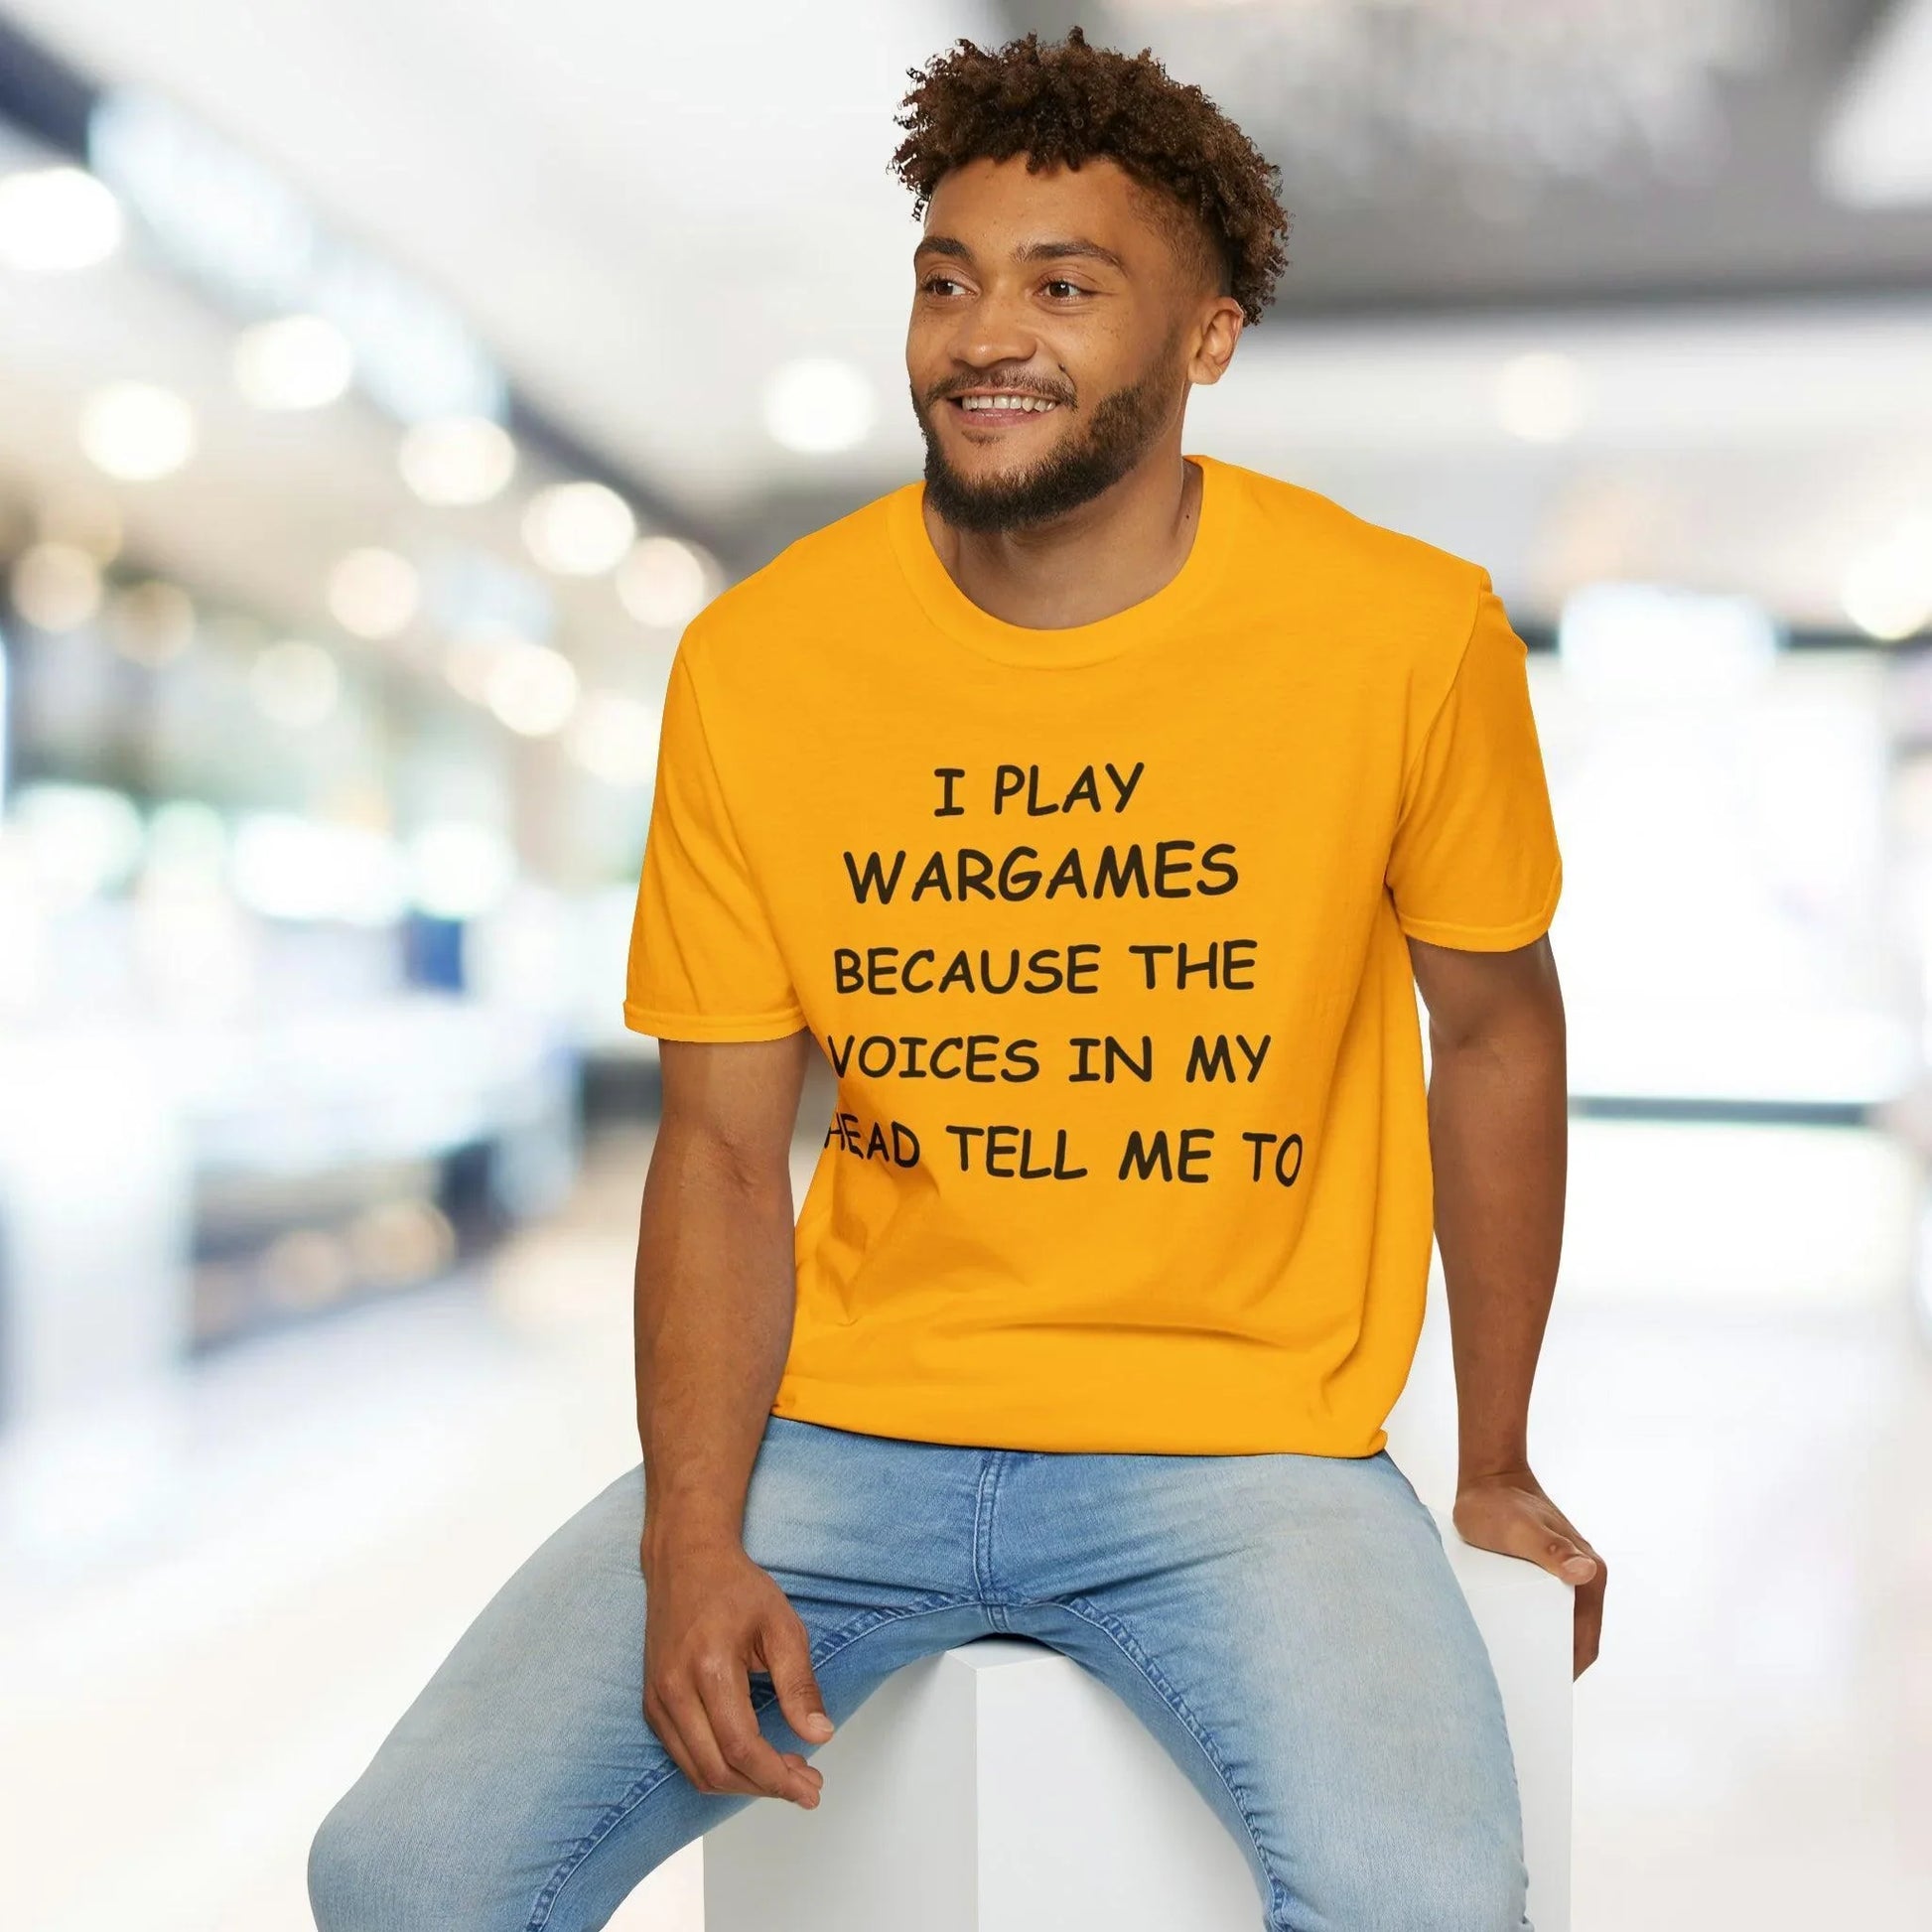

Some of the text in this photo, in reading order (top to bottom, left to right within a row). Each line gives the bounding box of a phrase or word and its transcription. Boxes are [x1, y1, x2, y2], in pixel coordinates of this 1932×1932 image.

[934, 761, 1145, 817] I PLAY
[843, 840, 1239, 905] WARGAMES
[834, 939, 1258, 995] BECAUSE THE
[827, 1035, 1271, 1083] VOICES IN MY
[823, 1112, 1303, 1187] HEAD TELL ME TO
